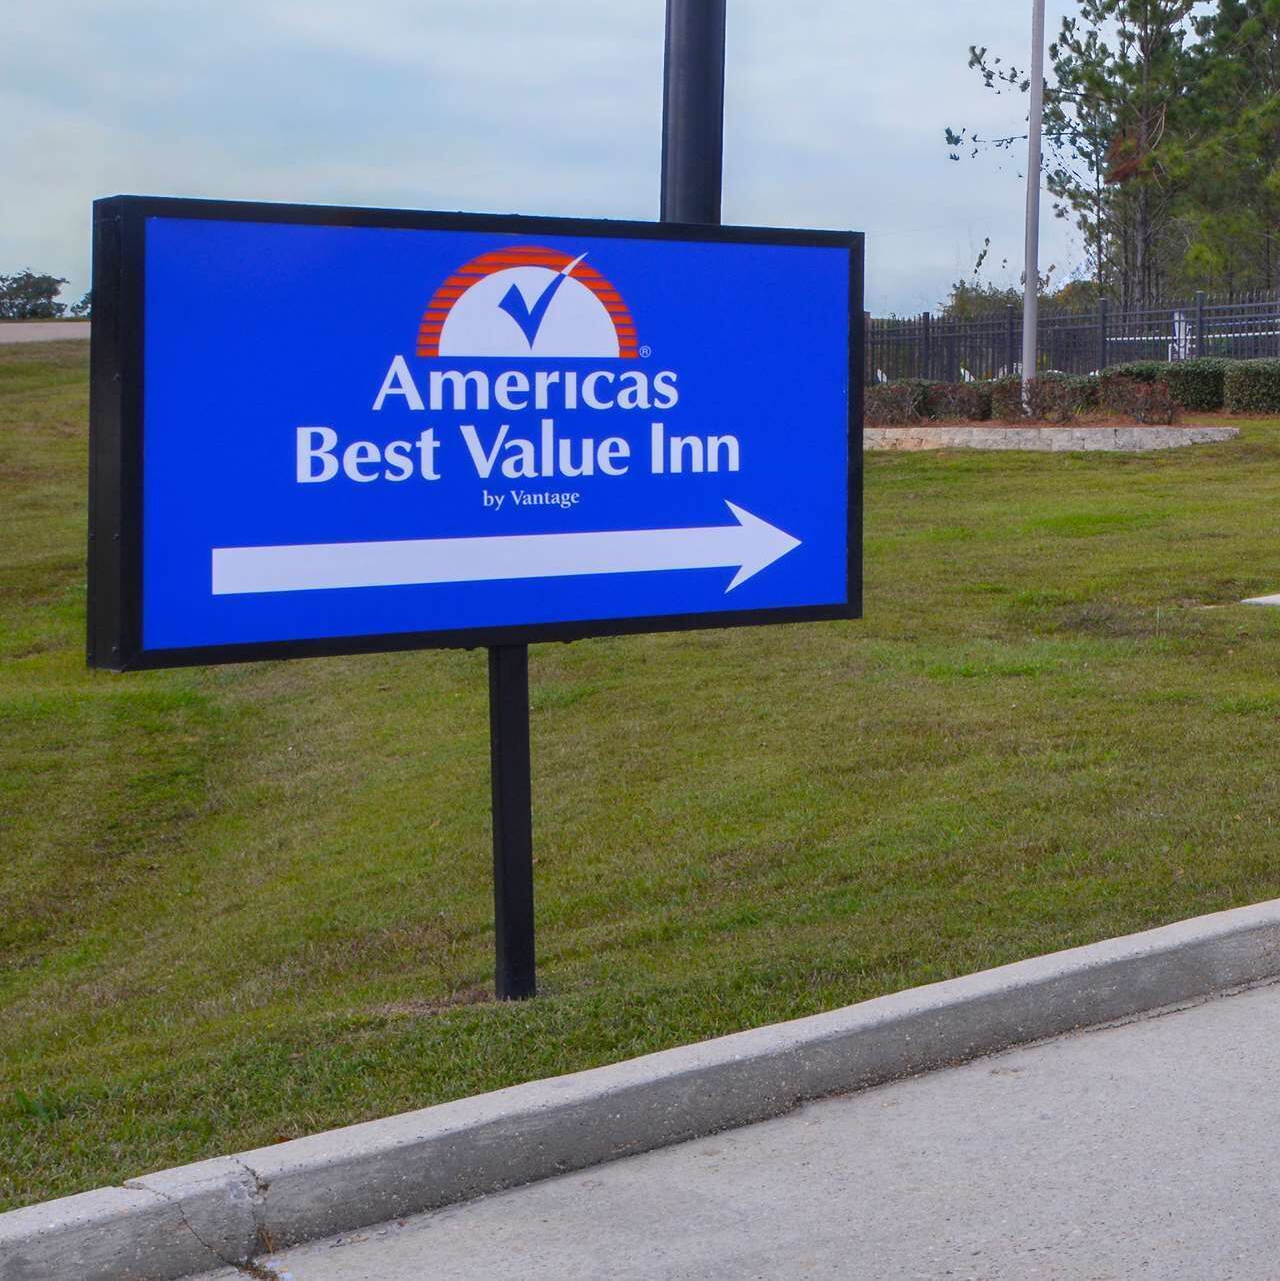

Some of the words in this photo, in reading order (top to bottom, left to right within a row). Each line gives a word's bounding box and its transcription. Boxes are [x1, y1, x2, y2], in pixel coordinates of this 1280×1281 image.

[372, 354, 679, 411] Americas
[296, 426, 441, 483] Best
[459, 418, 631, 479] Value
[651, 422, 740, 474] Inn
[482, 490, 505, 511] by
[510, 489, 580, 509] Vantage
